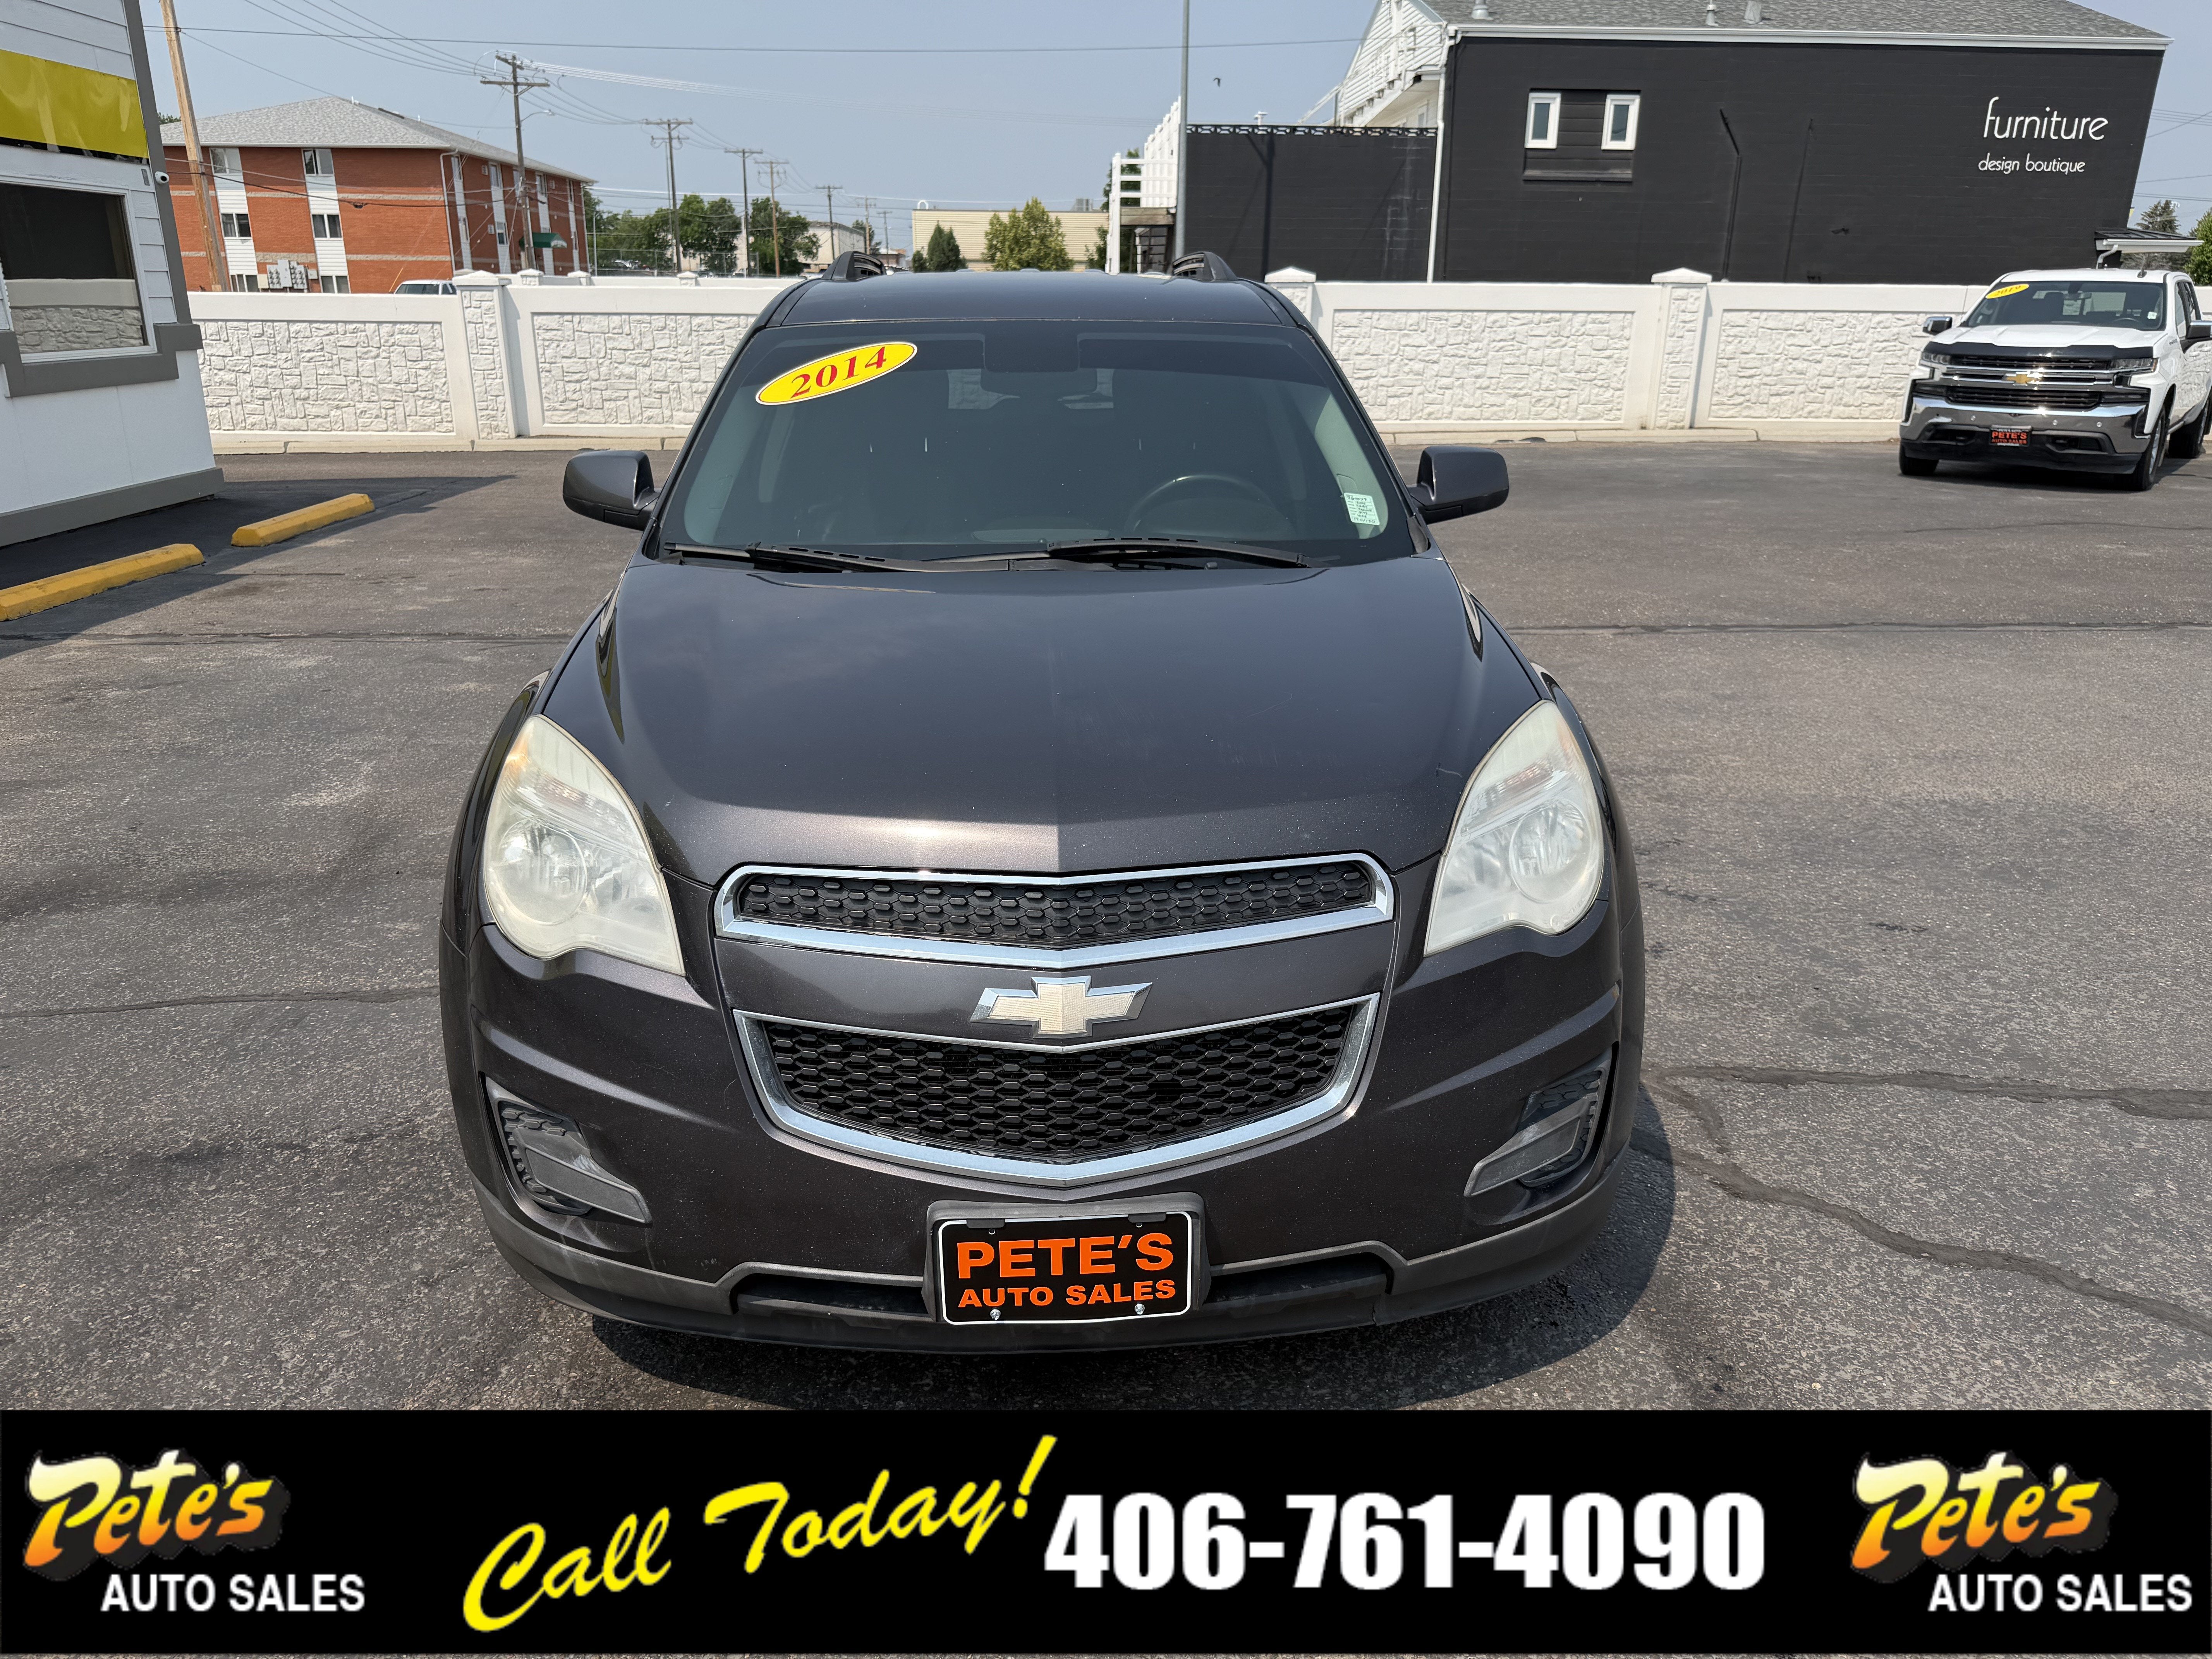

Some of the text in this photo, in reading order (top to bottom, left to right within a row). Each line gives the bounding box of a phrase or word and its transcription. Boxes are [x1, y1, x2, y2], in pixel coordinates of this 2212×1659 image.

[1983, 96, 2109, 140] furniture
[1978, 152, 2086, 175] design boutique
[790, 347, 887, 398] 2014
[1992, 431, 2027, 439] PETE'S
[957, 1233, 1173, 1279] PETE'S
[958, 1279, 1176, 1308] AUTO SALES
